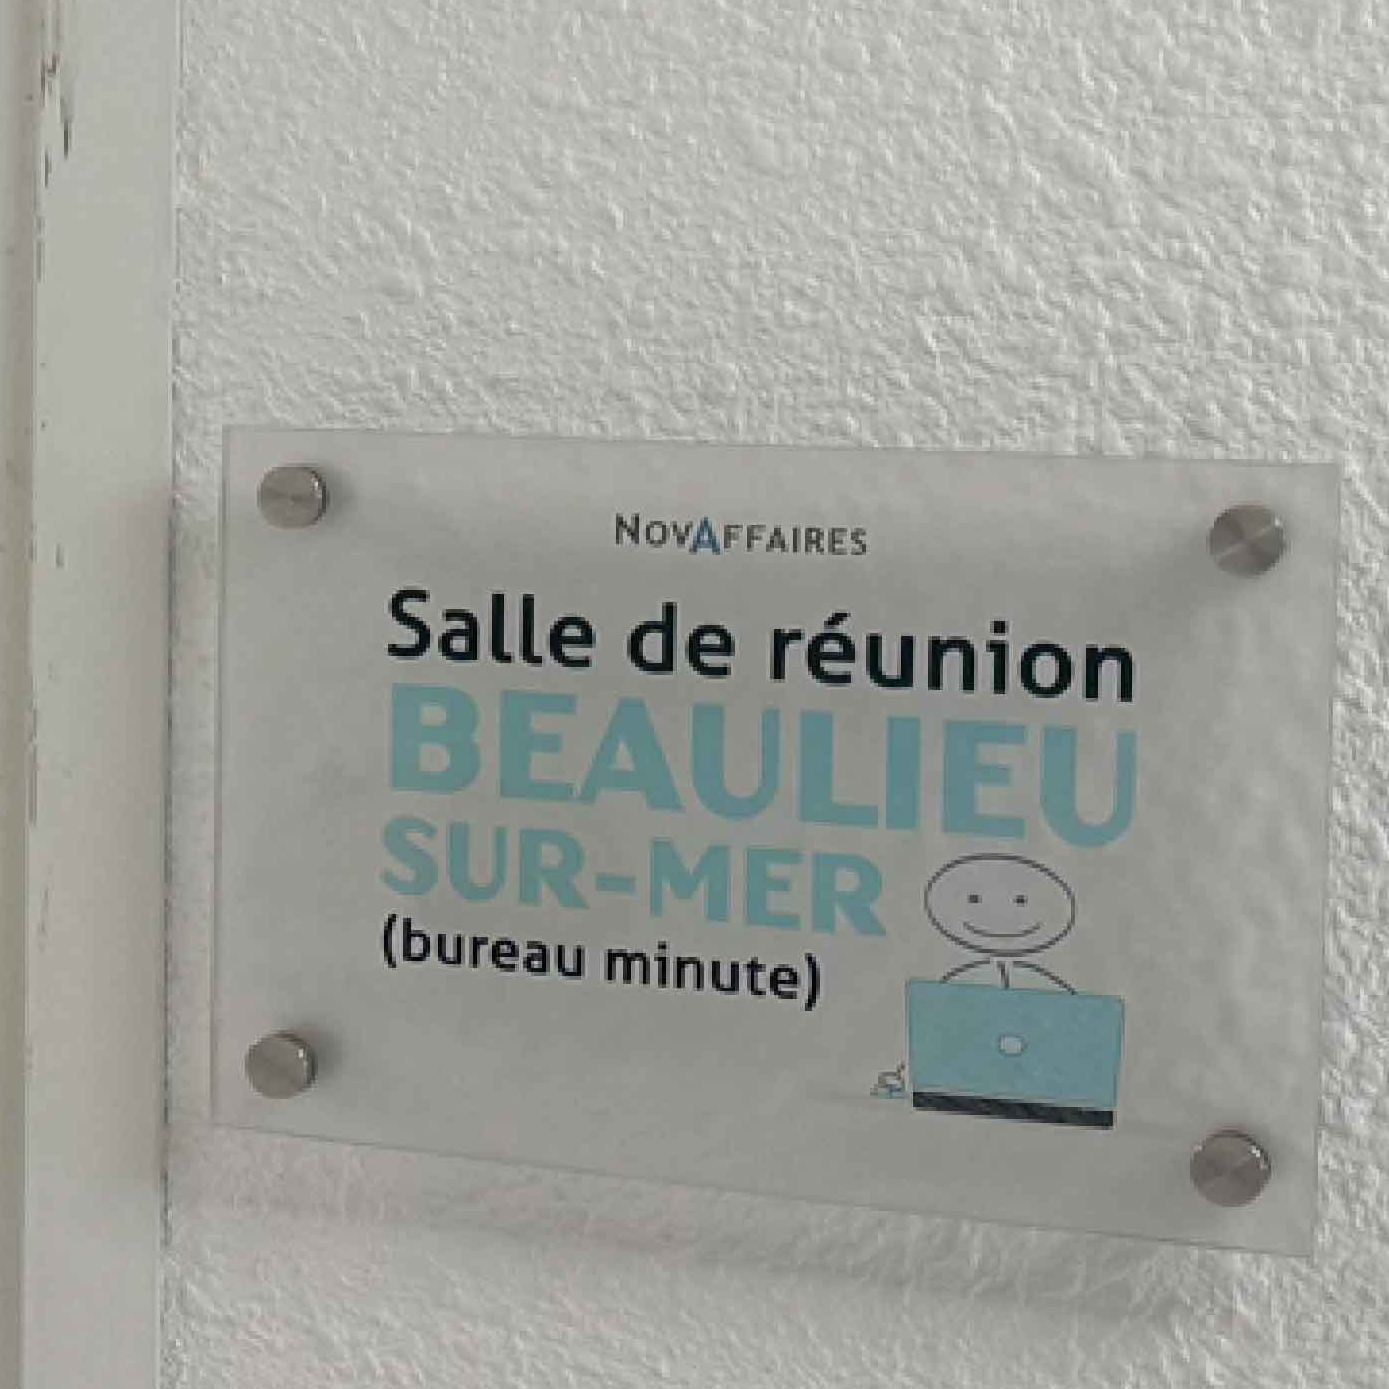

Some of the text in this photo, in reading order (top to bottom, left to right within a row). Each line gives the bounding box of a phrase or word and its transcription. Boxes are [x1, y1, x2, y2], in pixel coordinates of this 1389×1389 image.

[386, 588, 1135, 704] Salle de réunion
[388, 683, 1136, 848] BEAULIEU
[382, 817, 889, 937] SUR-MER
[382, 913, 823, 1012] (bureau minute)
